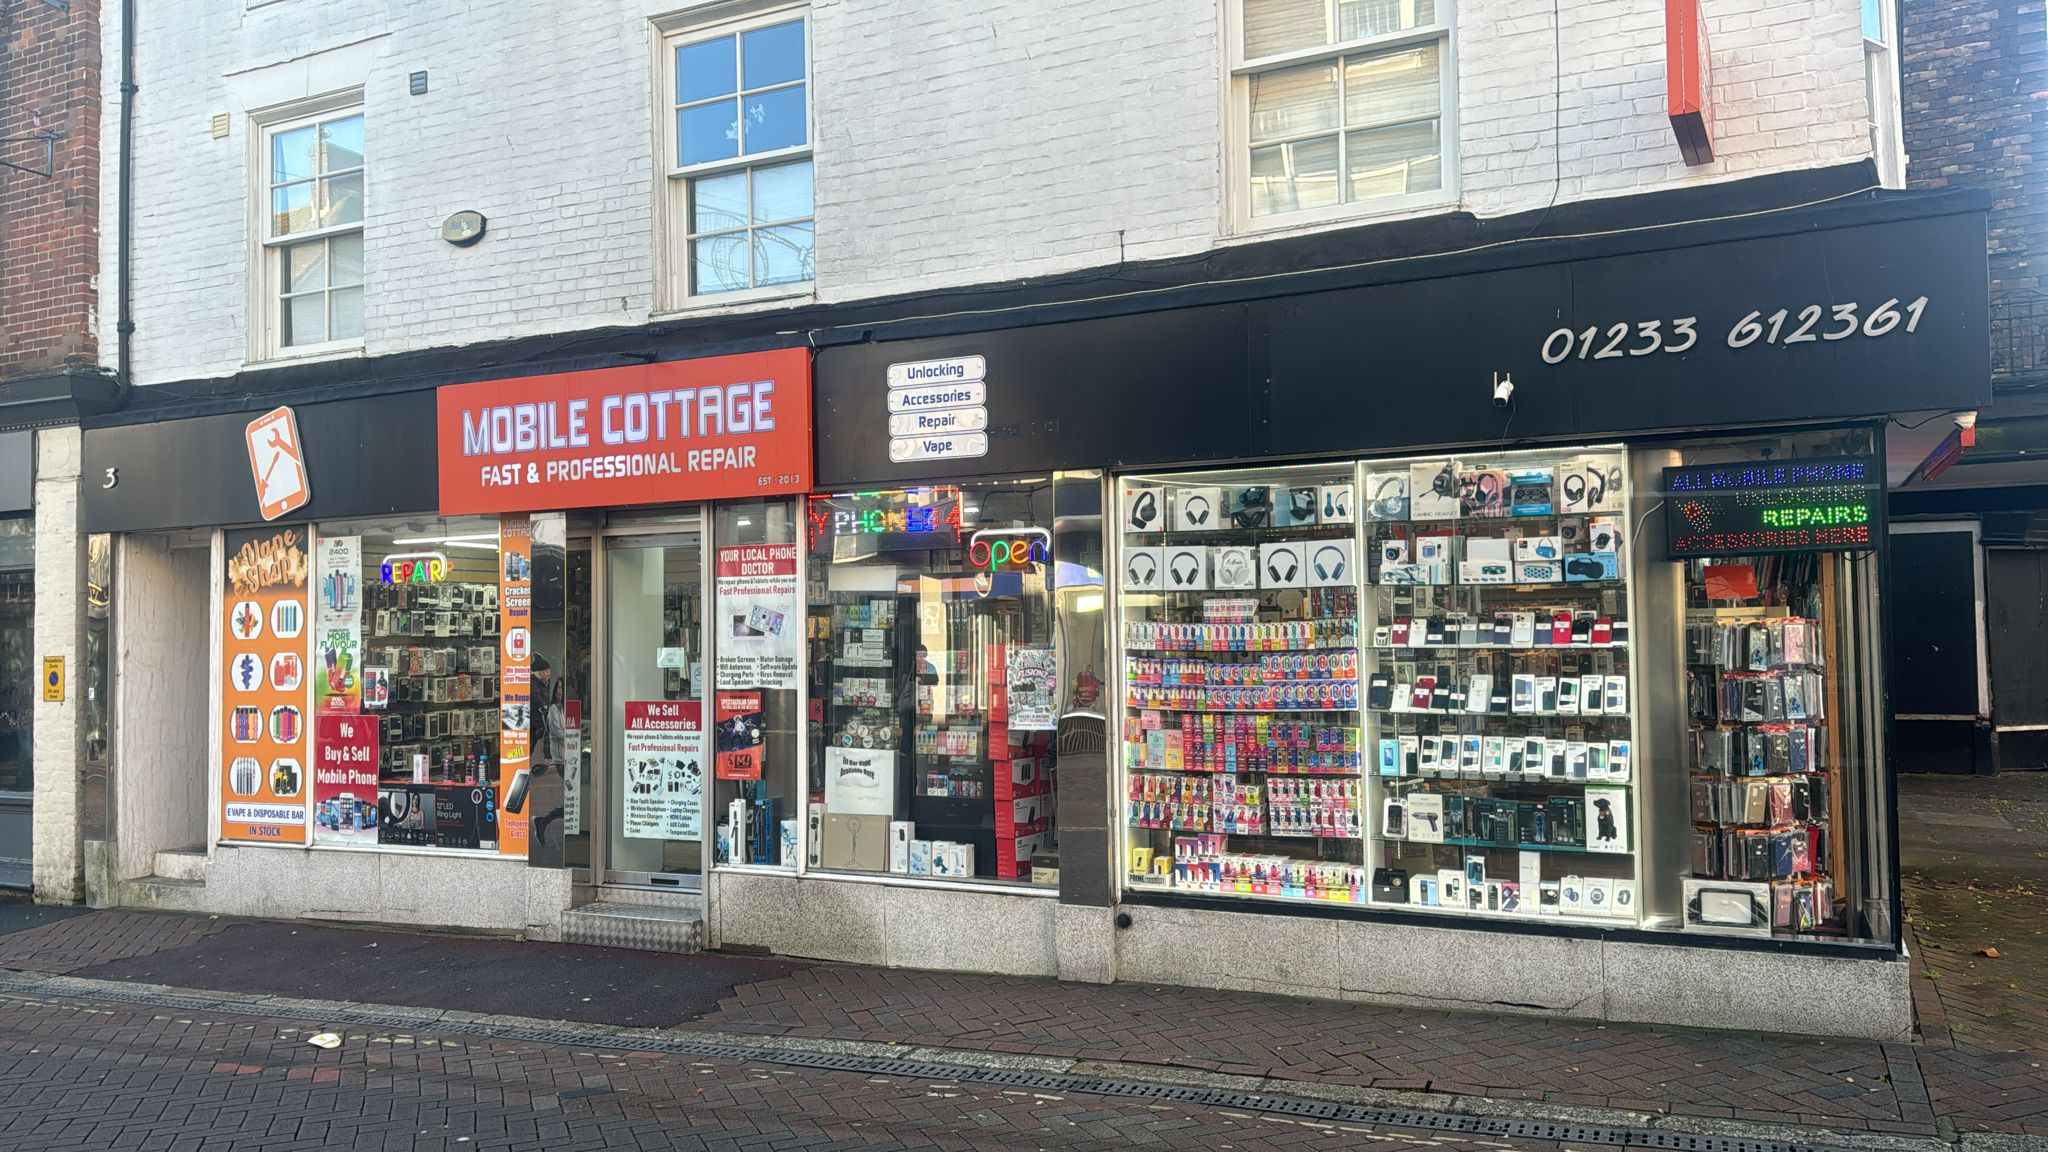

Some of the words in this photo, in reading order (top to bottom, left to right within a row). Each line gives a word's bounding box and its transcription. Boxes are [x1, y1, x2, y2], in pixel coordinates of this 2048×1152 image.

[1541, 316, 1698, 364] 01233
[1727, 296, 1929, 348] 612361
[907, 363, 964, 379] Unlocking
[902, 389, 971, 407] Accessories
[462, 398, 590, 457] MOBILE
[601, 379, 776, 445] COTTAGE
[918, 413, 956, 429] Repair
[923, 440, 953, 454] Vape
[481, 463, 522, 487] FAST
[526, 464, 540, 483] &
[546, 452, 681, 482] PROFESSIONAL
[687, 445, 757, 473] REPAIR
[102, 467, 118, 489] 3
[757, 475, 774, 486] EST
[778, 474, 800, 484] 2013
[1672, 474, 1708, 491] ALL
[1711, 468, 1786, 488] MOBILE
[1792, 463, 1865, 483] PHONE
[1735, 484, 1867, 506] UNLOCKING
[1763, 505, 1869, 527] REPAIRS
[241, 529, 297, 567] Vape
[1675, 529, 1810, 551] ACCESSORIES
[720, 549, 739, 562] YOUR
[741, 548, 768, 561] LOCAL
[770, 547, 797, 560] PHONE
[969, 540, 1048, 571] open
[246, 557, 292, 593] Shop
[382, 560, 442, 585] REPAIR
[741, 562, 775, 576] DOCTOR
[719, 587, 733, 596] Fast
[733, 586, 772, 595] Professional
[773, 586, 796, 597] Repairs
[320, 640, 357, 649] FLAVOUR
[327, 632, 351, 641] MORE
[720, 671, 741, 679] Charging
[732, 679, 753, 687] Speakers
[760, 679, 783, 687] Unlocking
[647, 704, 660, 716] We
[661, 704, 679, 716] Sell
[340, 722, 354, 738] We
[631, 718, 643, 729] All
[644, 718, 697, 730] Accessories
[325, 746, 341, 765] Buy
[342, 746, 350, 761] &
[351, 746, 370, 762] Sell
[628, 742, 640, 751] Fast
[641, 743, 676, 752] Professional
[677, 743, 699, 754] Repairs
[317, 768, 347, 785] Mobile
[348, 769, 377, 785] Phone
[840, 768, 863, 777] Available
[227, 808, 231, 816] E
[232, 808, 246, 817] VAPE
[247, 809, 252, 817] &
[253, 809, 290, 819] DISPOSABLE
[291, 810, 304, 820] BAR
[249, 826, 257, 835] IN
[258, 826, 281, 836] STOCK
